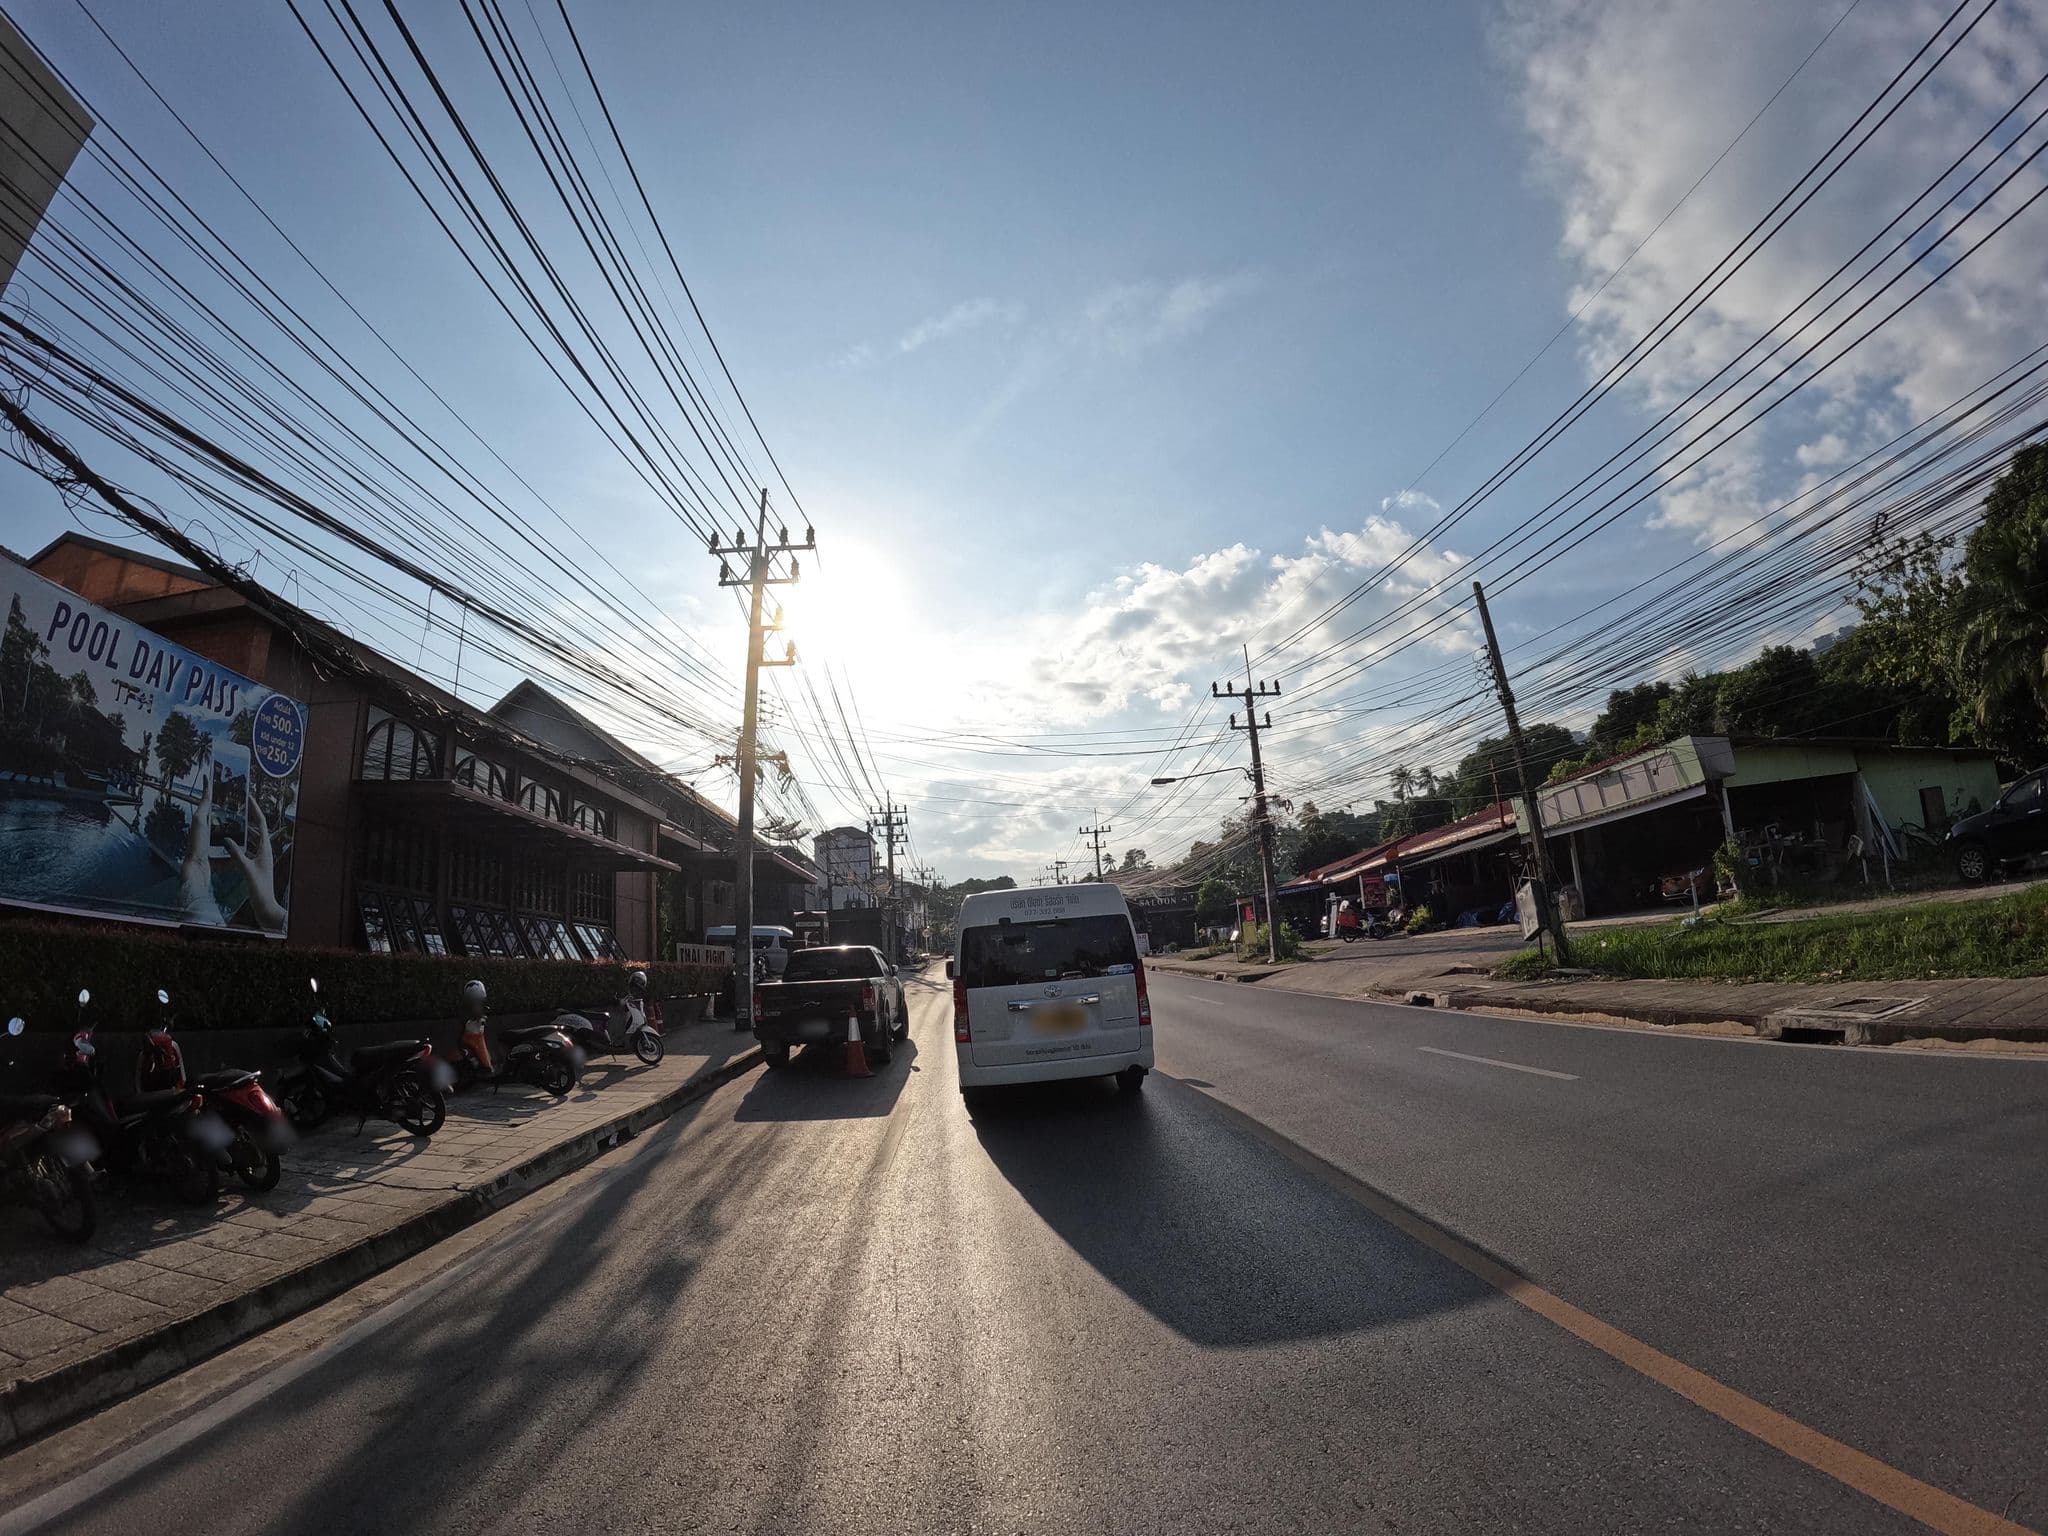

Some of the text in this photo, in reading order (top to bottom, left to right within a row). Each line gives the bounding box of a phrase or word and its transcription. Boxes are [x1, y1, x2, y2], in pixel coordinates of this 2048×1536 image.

[47, 601, 240, 717] POOL DAY PASS
[1138, 897, 1177, 907] SALOON
[680, 947, 725, 964] THAI FIGHT
